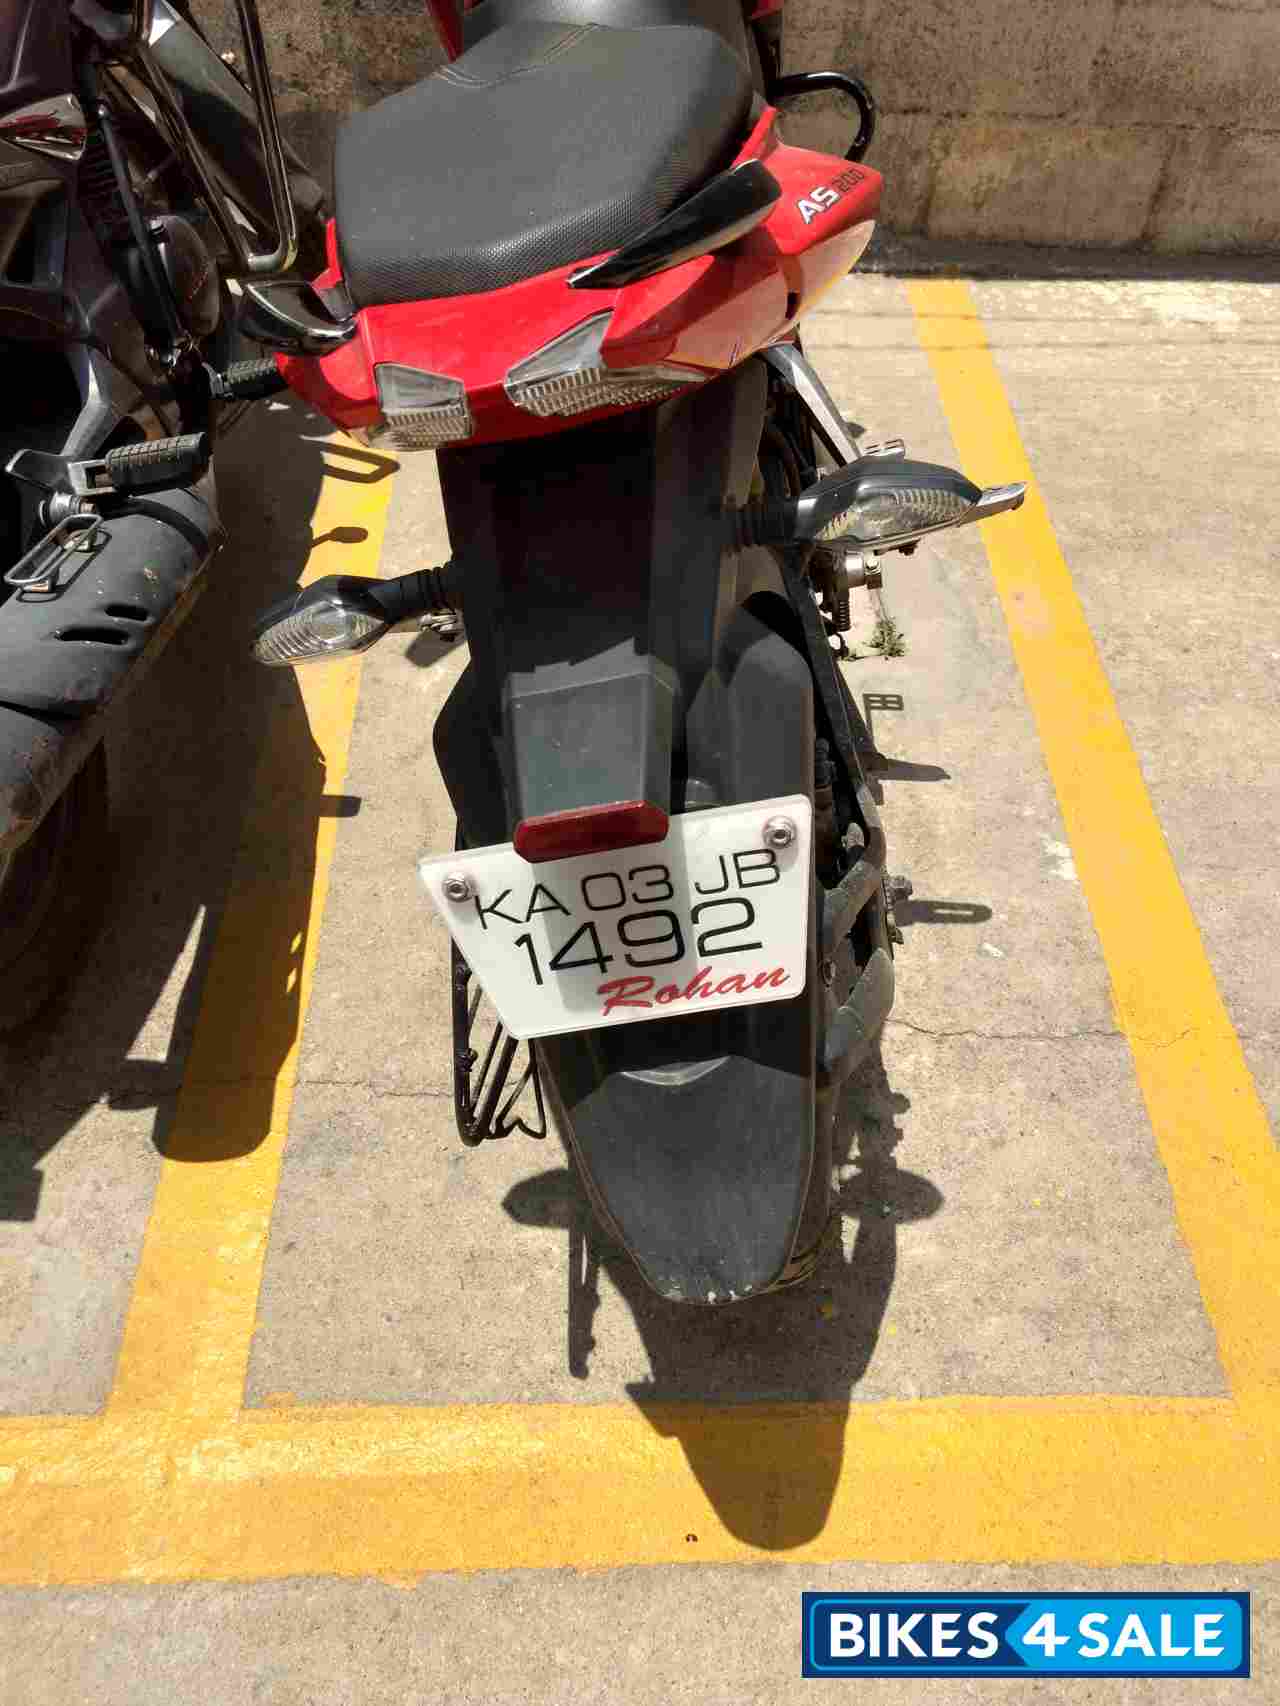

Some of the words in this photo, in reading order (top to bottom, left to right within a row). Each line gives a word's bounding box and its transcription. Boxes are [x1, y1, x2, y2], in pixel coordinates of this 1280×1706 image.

[797, 186, 840, 224] AS
[831, 168, 865, 192] 200
[474, 883, 571, 930] KA
[581, 864, 675, 911] 03
[695, 848, 781, 895] JB
[514, 897, 763, 985] 1492
[597, 966, 790, 1017] Rohan
